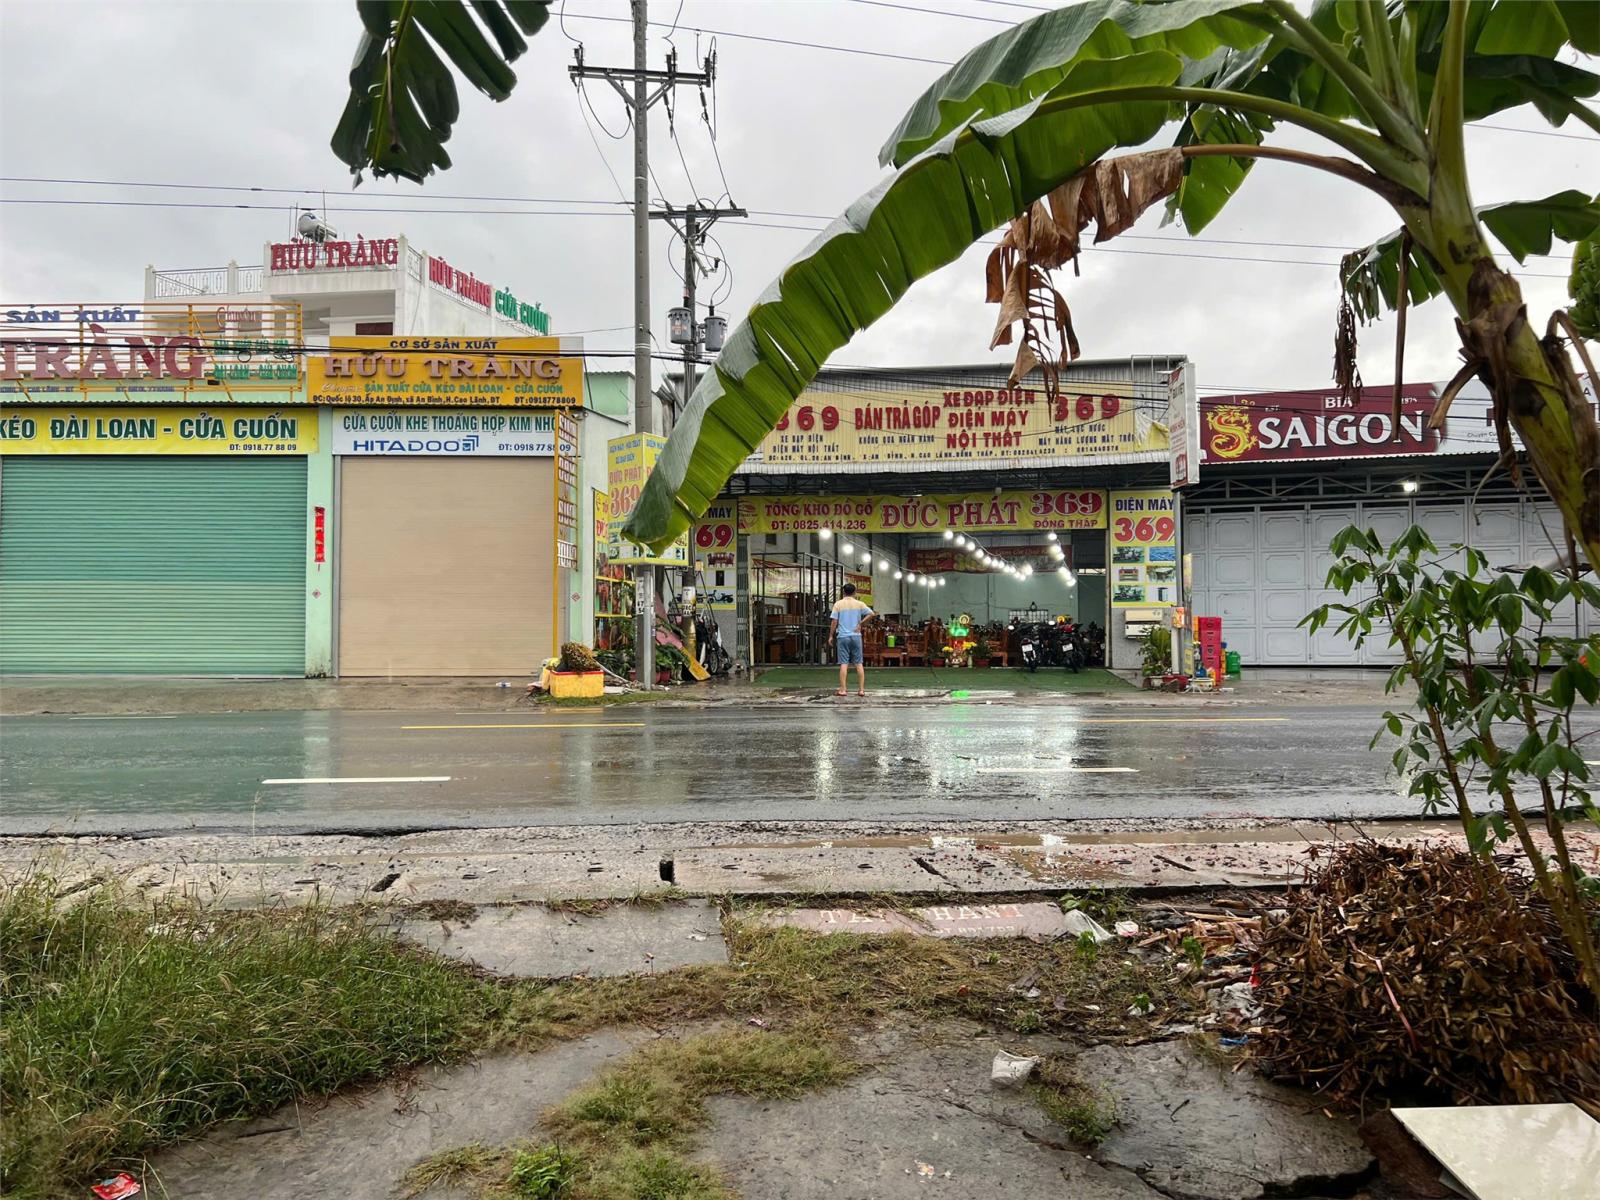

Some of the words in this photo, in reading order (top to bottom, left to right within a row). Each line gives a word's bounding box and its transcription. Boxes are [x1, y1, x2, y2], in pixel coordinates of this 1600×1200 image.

[324, 233, 399, 268] TRÀNG
[390, 340, 408, 349] CƠ
[413, 338, 430, 349] SỞ
[434, 338, 459, 349] SẢN
[465, 338, 498, 349] XUẤT
[855, 403, 883, 431] BÁN
[913, 400, 941, 430] GÓP
[991, 407, 1029, 426] MÁY
[1055, 394, 1120, 421] 369
[943, 392, 960, 408] XE
[1324, 396, 1354, 409] BIA
[50, 414, 89, 439] ĐÀI
[96, 419, 156, 439] LOAN
[179, 411, 227, 439] CỬA
[233, 411, 297, 439] CUỐN
[343, 411, 367, 431] CỬA
[370, 409, 402, 431] CUỐN
[405, 415, 429, 431] KHE
[481, 414, 506, 436] HỢP
[509, 416, 532, 431] KIM
[1257, 409, 1425, 449] SAIGON
[947, 429, 977, 451] NỘI
[803, 503, 830, 516] KHO
[881, 496, 938, 528] ĐỨC
[947, 495, 1021, 526] PHÁT
[1031, 491, 1103, 516] 369
[1115, 496, 1144, 514] ĐIỆN
[1148, 496, 1174, 511] MÁY
[771, 521, 790, 531] ĐT:
[792, 519, 867, 531] 0825.414.236
[1114, 516, 1175, 543] 369
